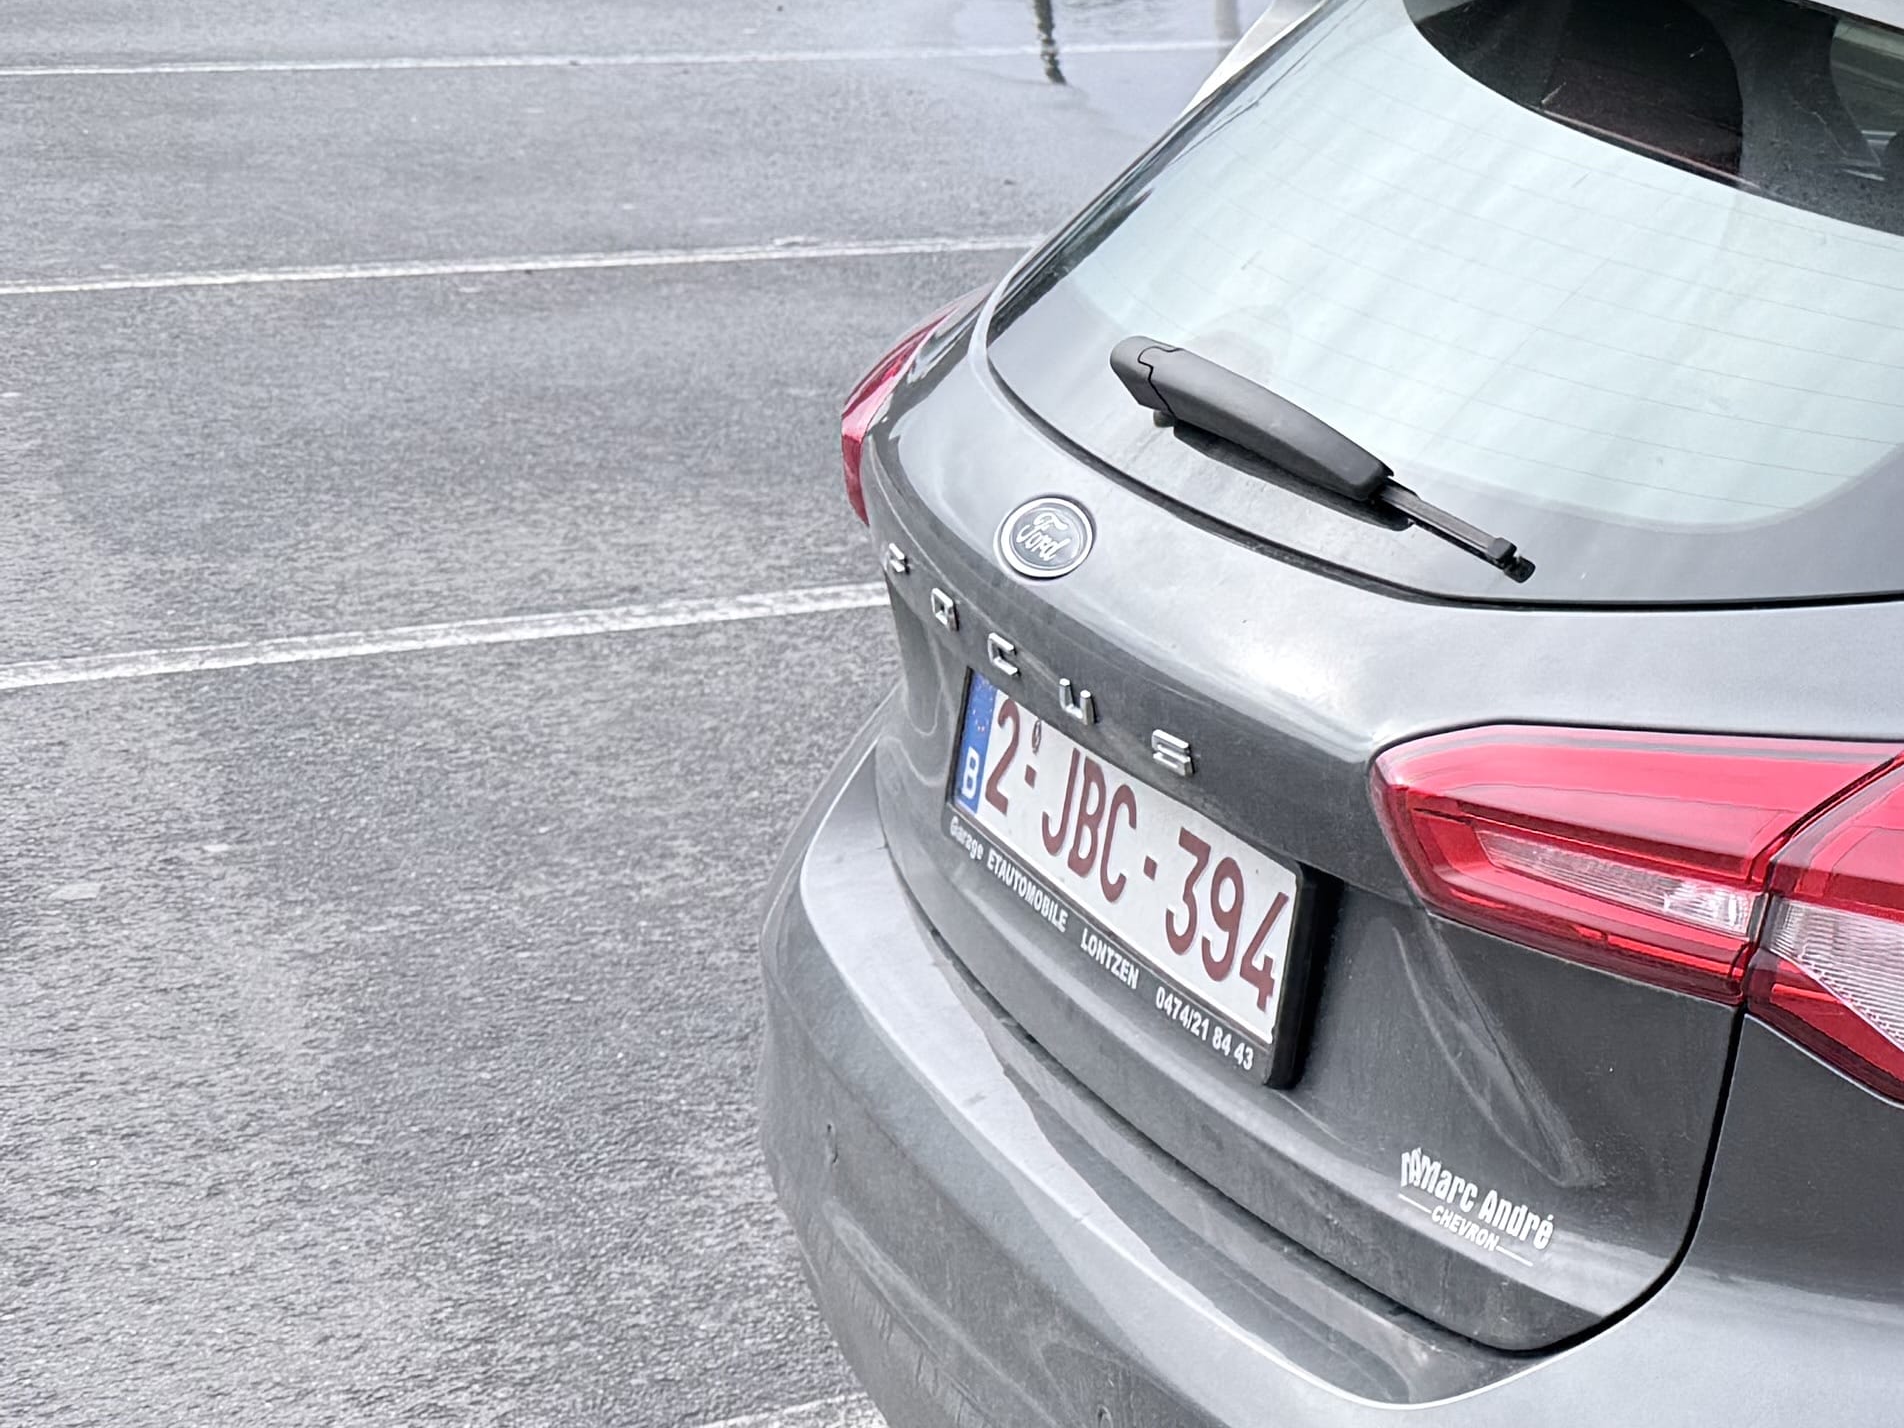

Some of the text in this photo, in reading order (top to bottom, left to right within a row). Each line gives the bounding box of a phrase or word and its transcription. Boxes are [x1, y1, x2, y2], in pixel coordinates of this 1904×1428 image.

[1016, 512, 1070, 561] Ford
[961, 747, 982, 799] B
[985, 699, 1289, 1012] 2-JBC-394
[950, 815, 984, 860] Garage
[1080, 928, 1140, 990] LONTZEN
[1155, 986, 1210, 1041] 0474/21
[1212, 1025, 1232, 1056] 84
[1233, 1042, 1254, 1070] 43
[1431, 1205, 1500, 1252] CHEVRON
